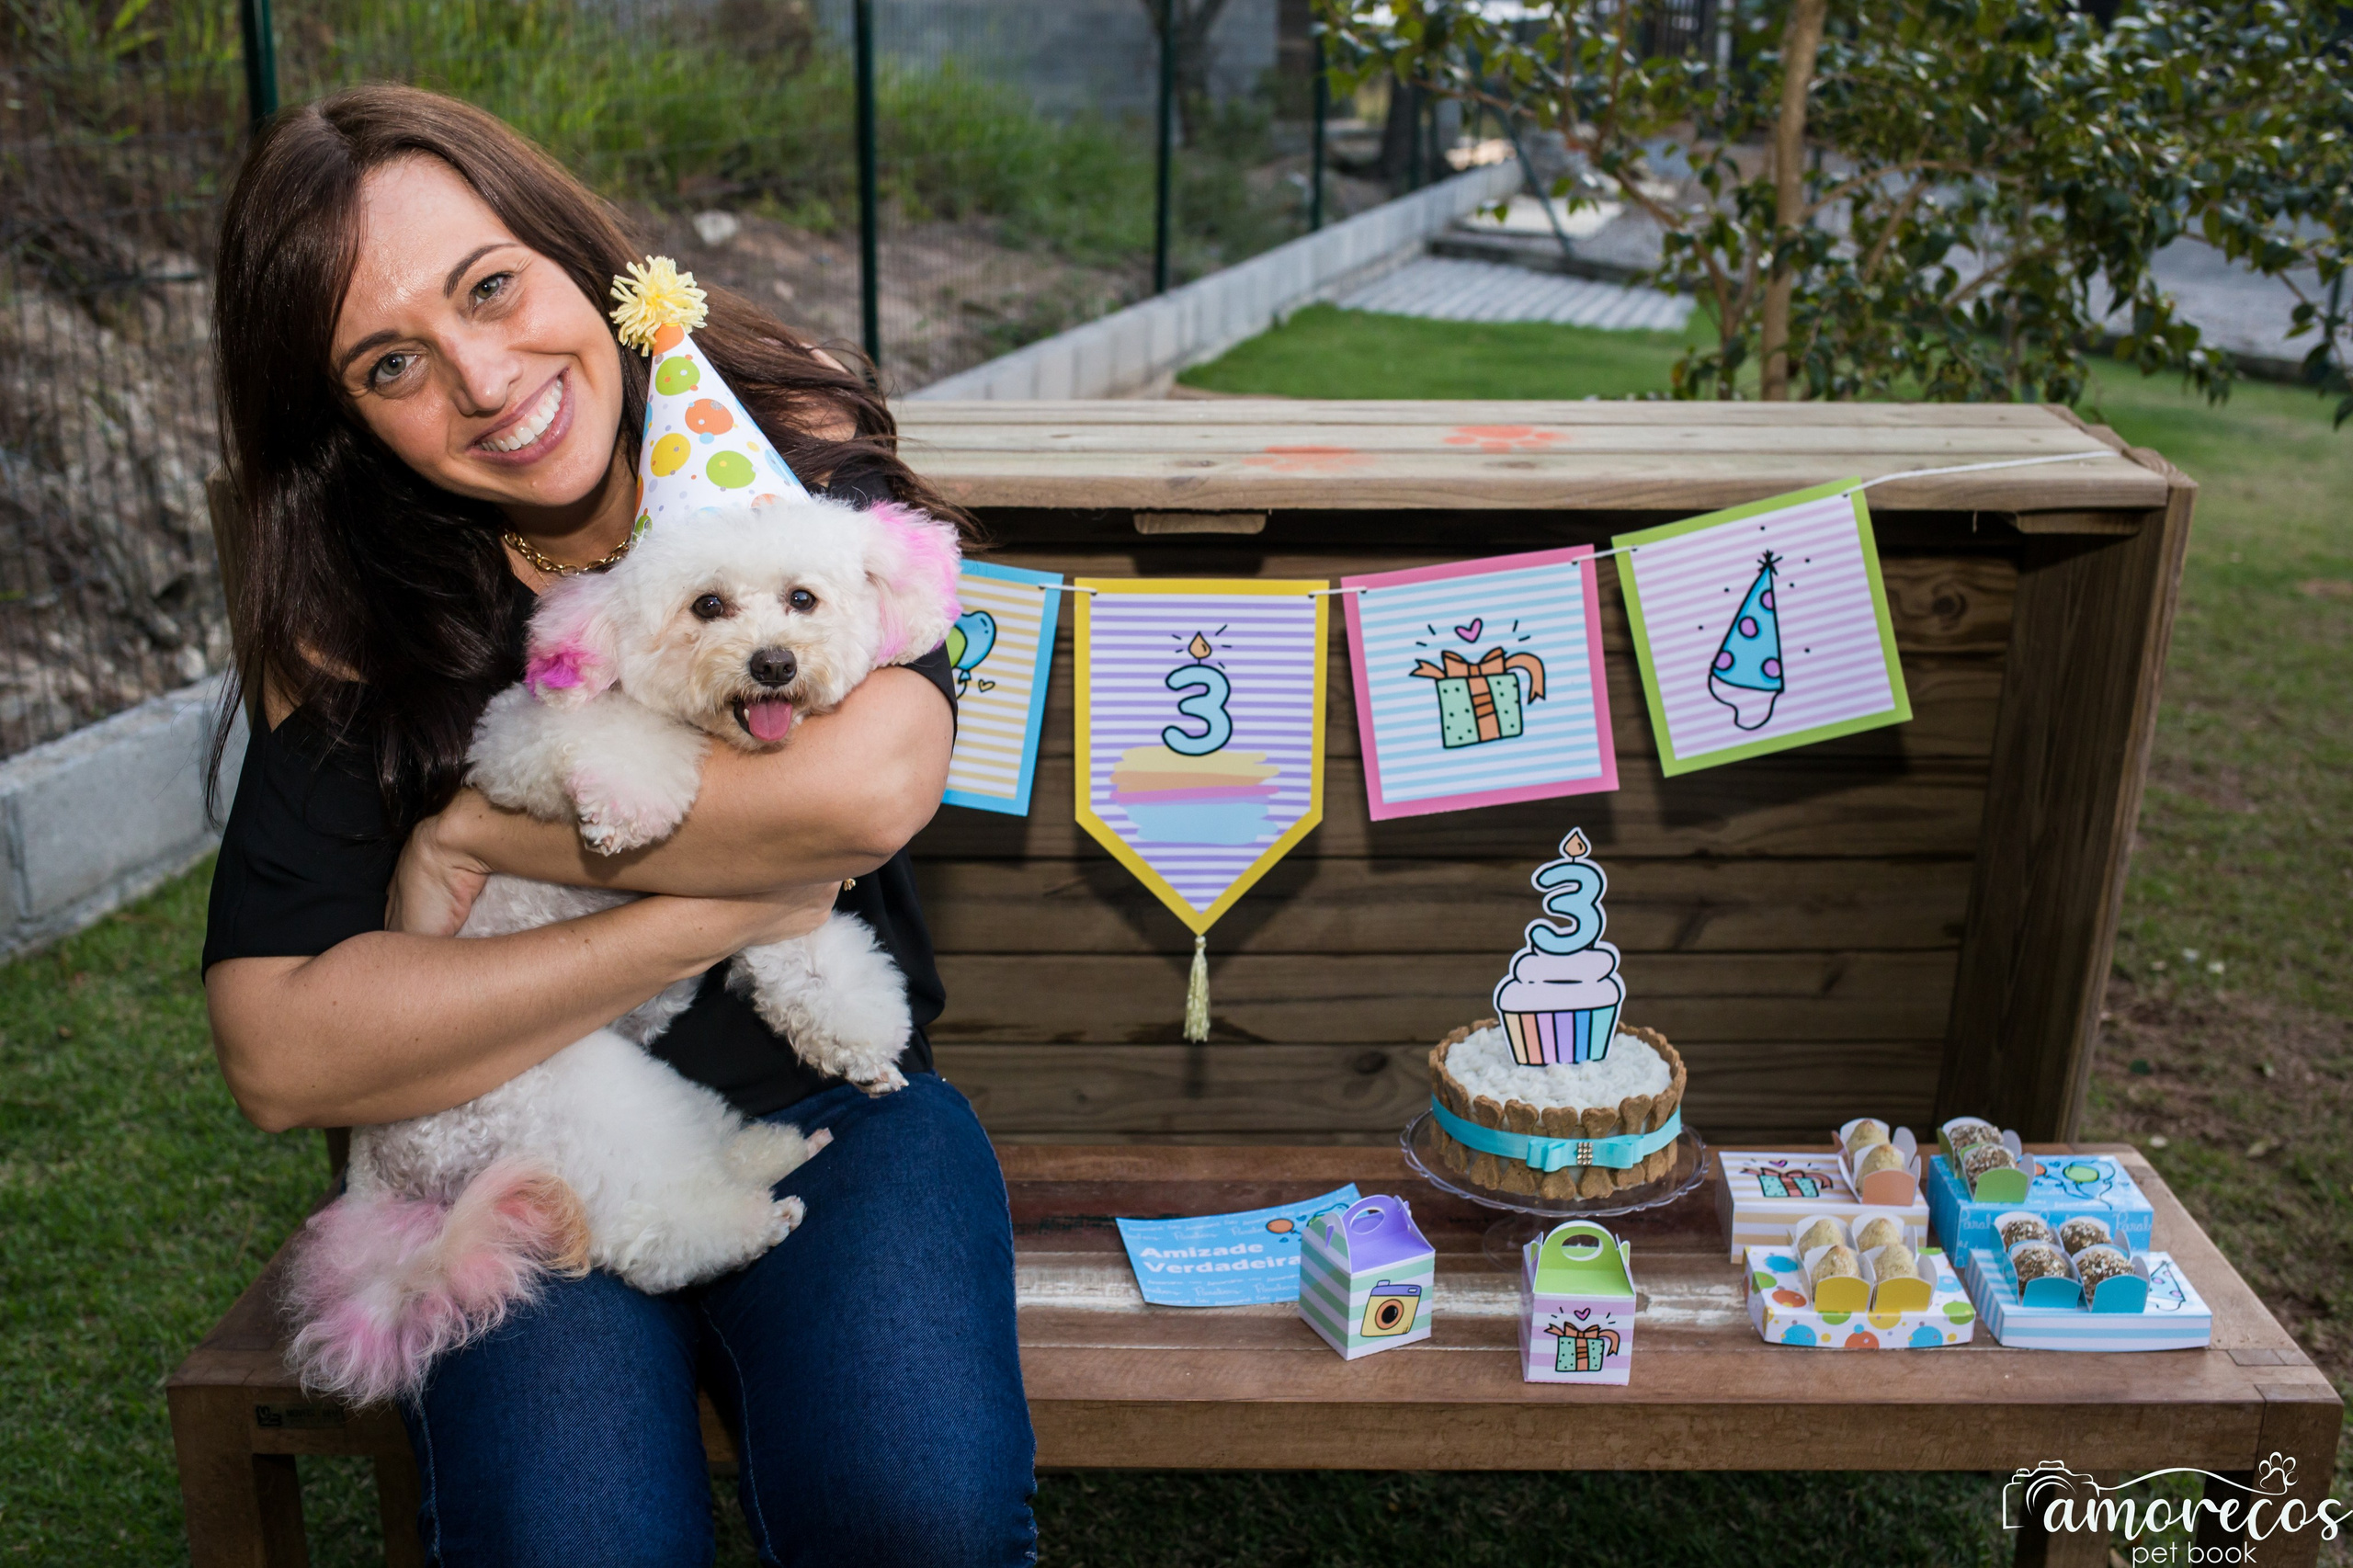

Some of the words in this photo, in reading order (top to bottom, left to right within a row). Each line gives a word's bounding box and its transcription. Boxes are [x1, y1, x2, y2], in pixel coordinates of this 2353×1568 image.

[1162, 664, 1233, 756] 3
[1529, 862, 1604, 957] 3
[1140, 1243, 1264, 1259] Amizade
[1142, 1256, 1301, 1275] Verdadeira
